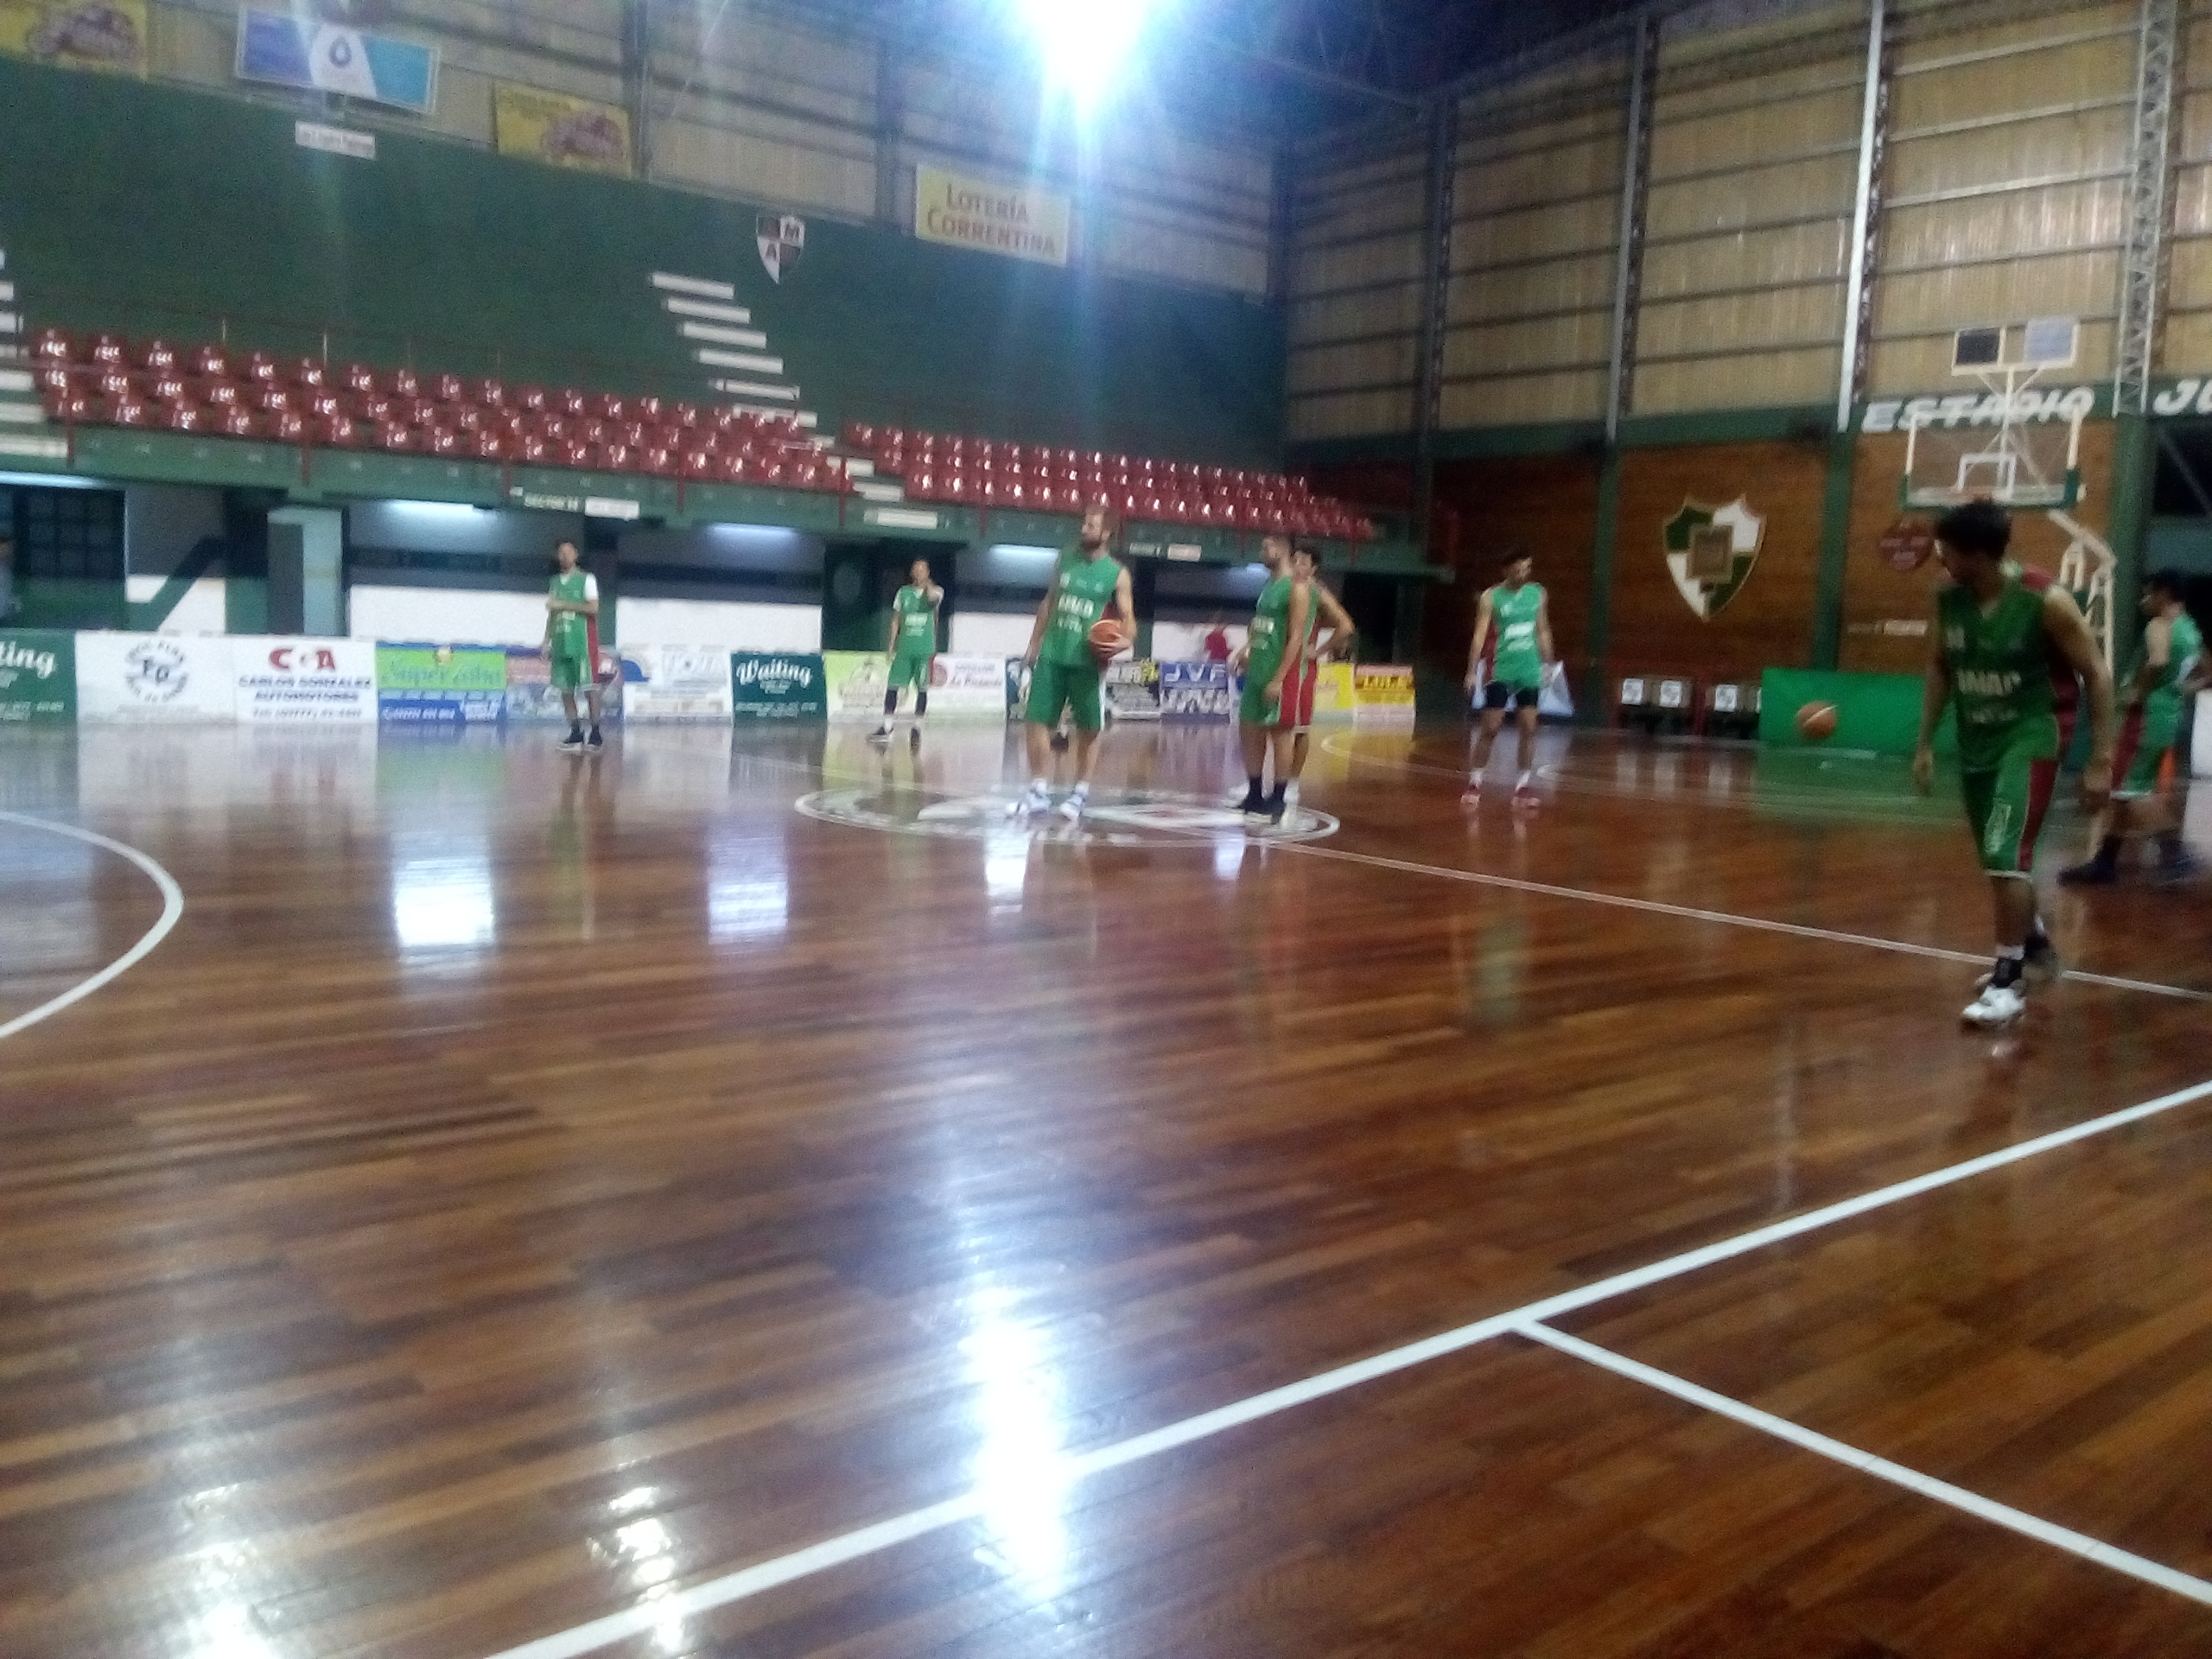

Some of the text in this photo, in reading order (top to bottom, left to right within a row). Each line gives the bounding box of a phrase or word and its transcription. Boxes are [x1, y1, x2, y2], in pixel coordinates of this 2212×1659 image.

[927, 207, 1056, 257] CORRENTINA
[1862, 386, 2095, 433] ESTADIO
[736, 658, 813, 689] Waiting
